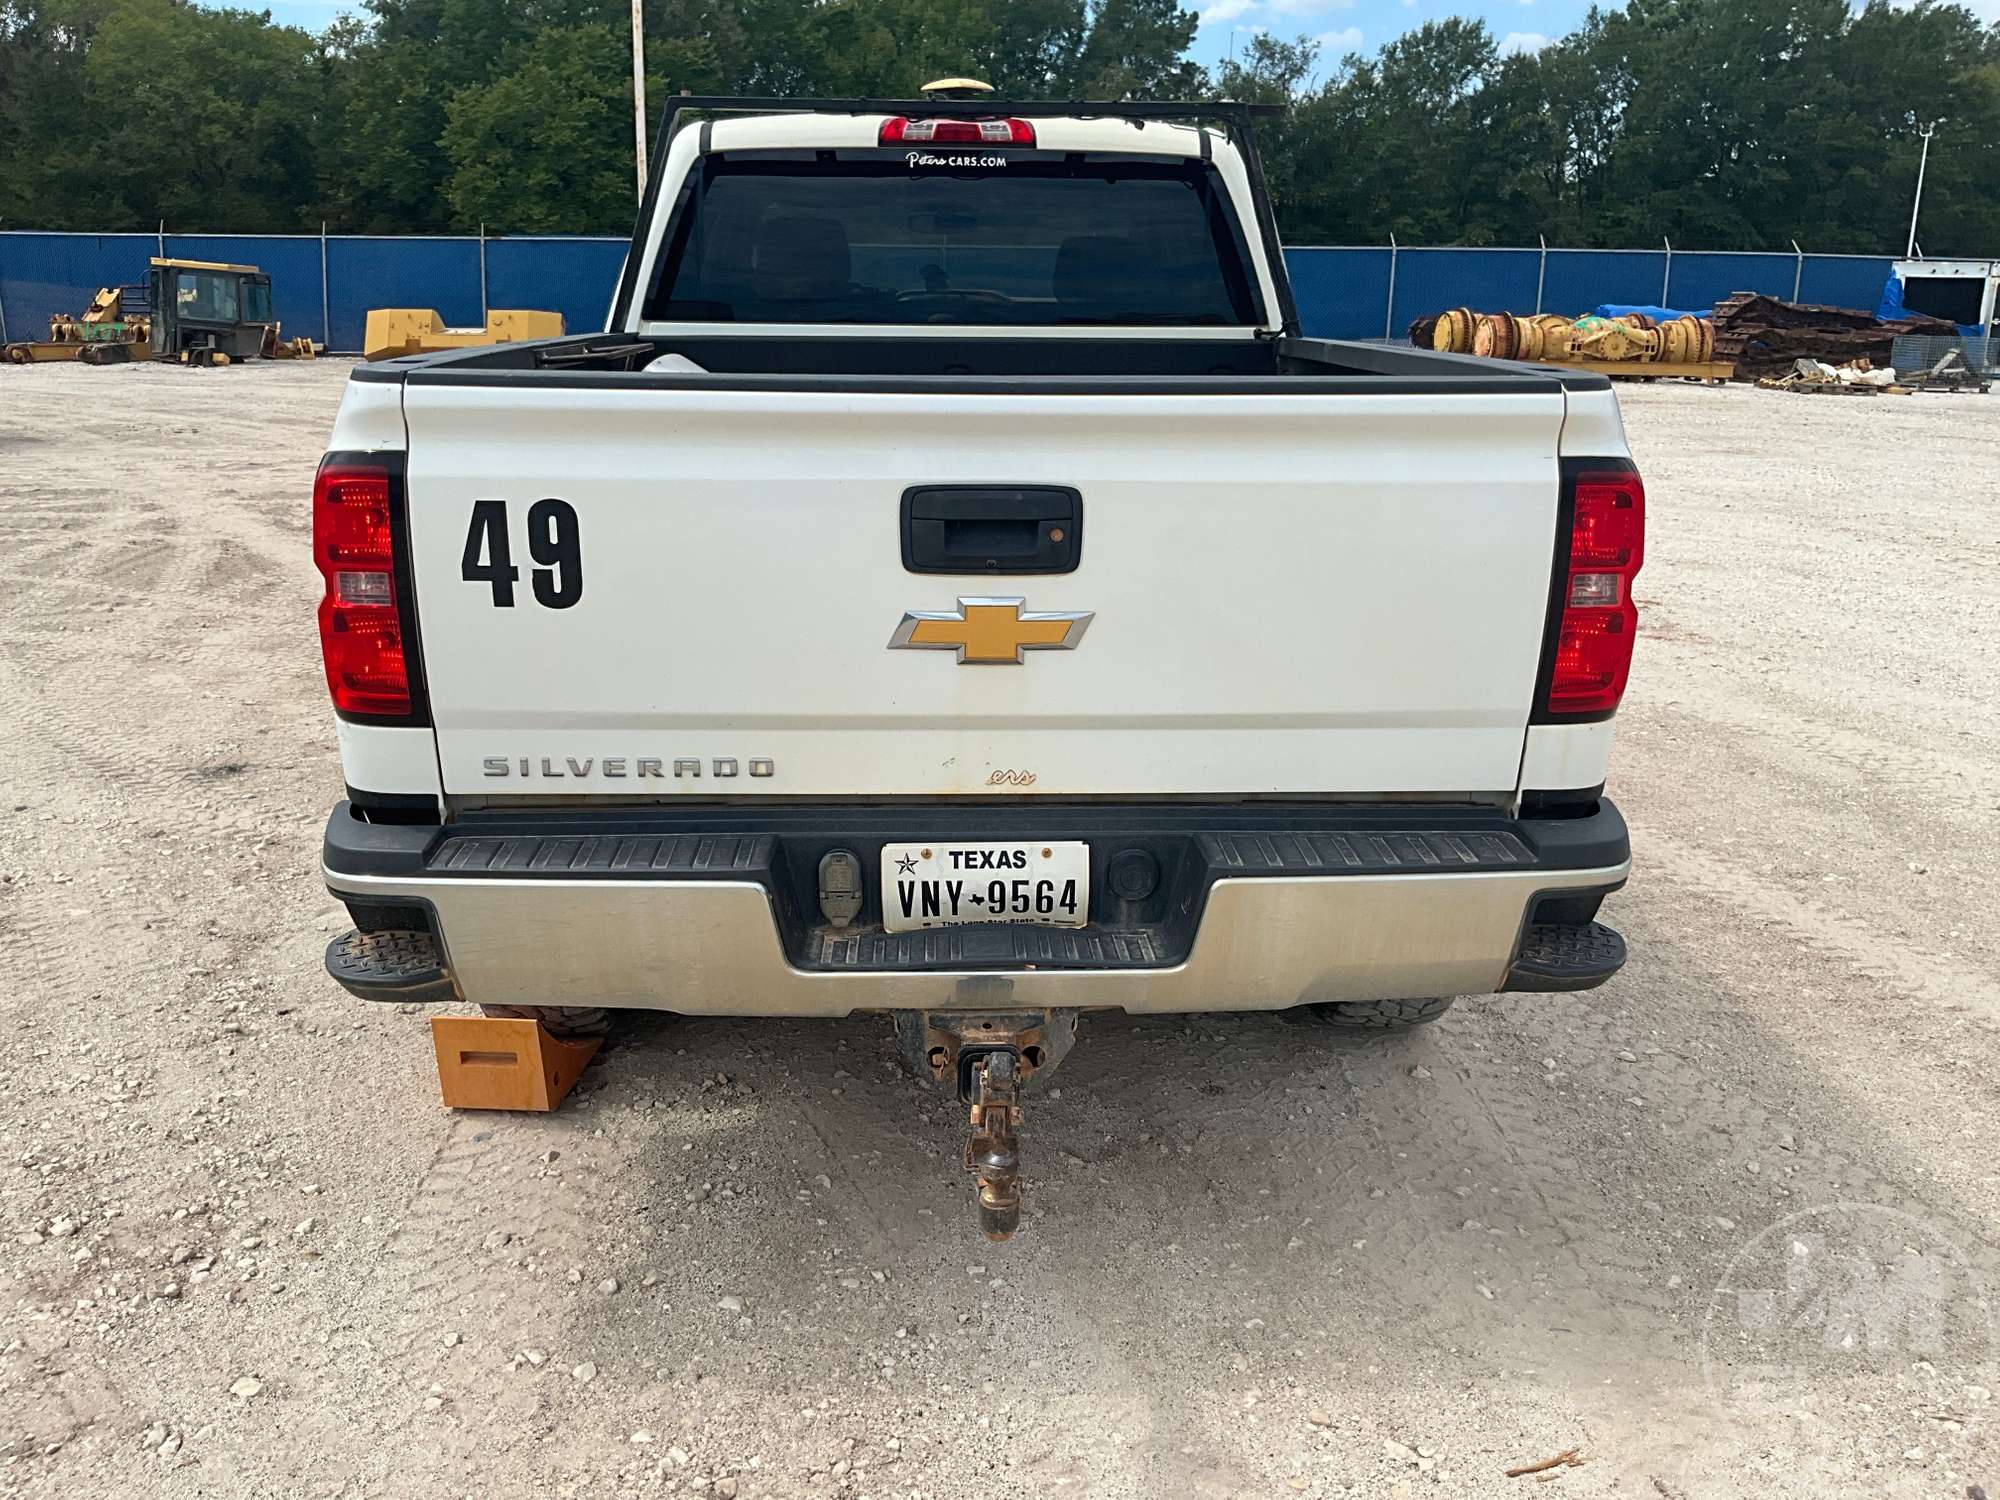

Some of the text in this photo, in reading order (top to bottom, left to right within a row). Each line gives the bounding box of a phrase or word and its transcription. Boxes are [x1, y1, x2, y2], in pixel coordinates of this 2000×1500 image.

[948, 156, 1006, 167] CARS.COM
[461, 498, 583, 609] 49
[483, 756, 774, 777] SILVERADO
[949, 850, 1027, 869] TEXAS
[898, 880, 1077, 918] VNY 9564
